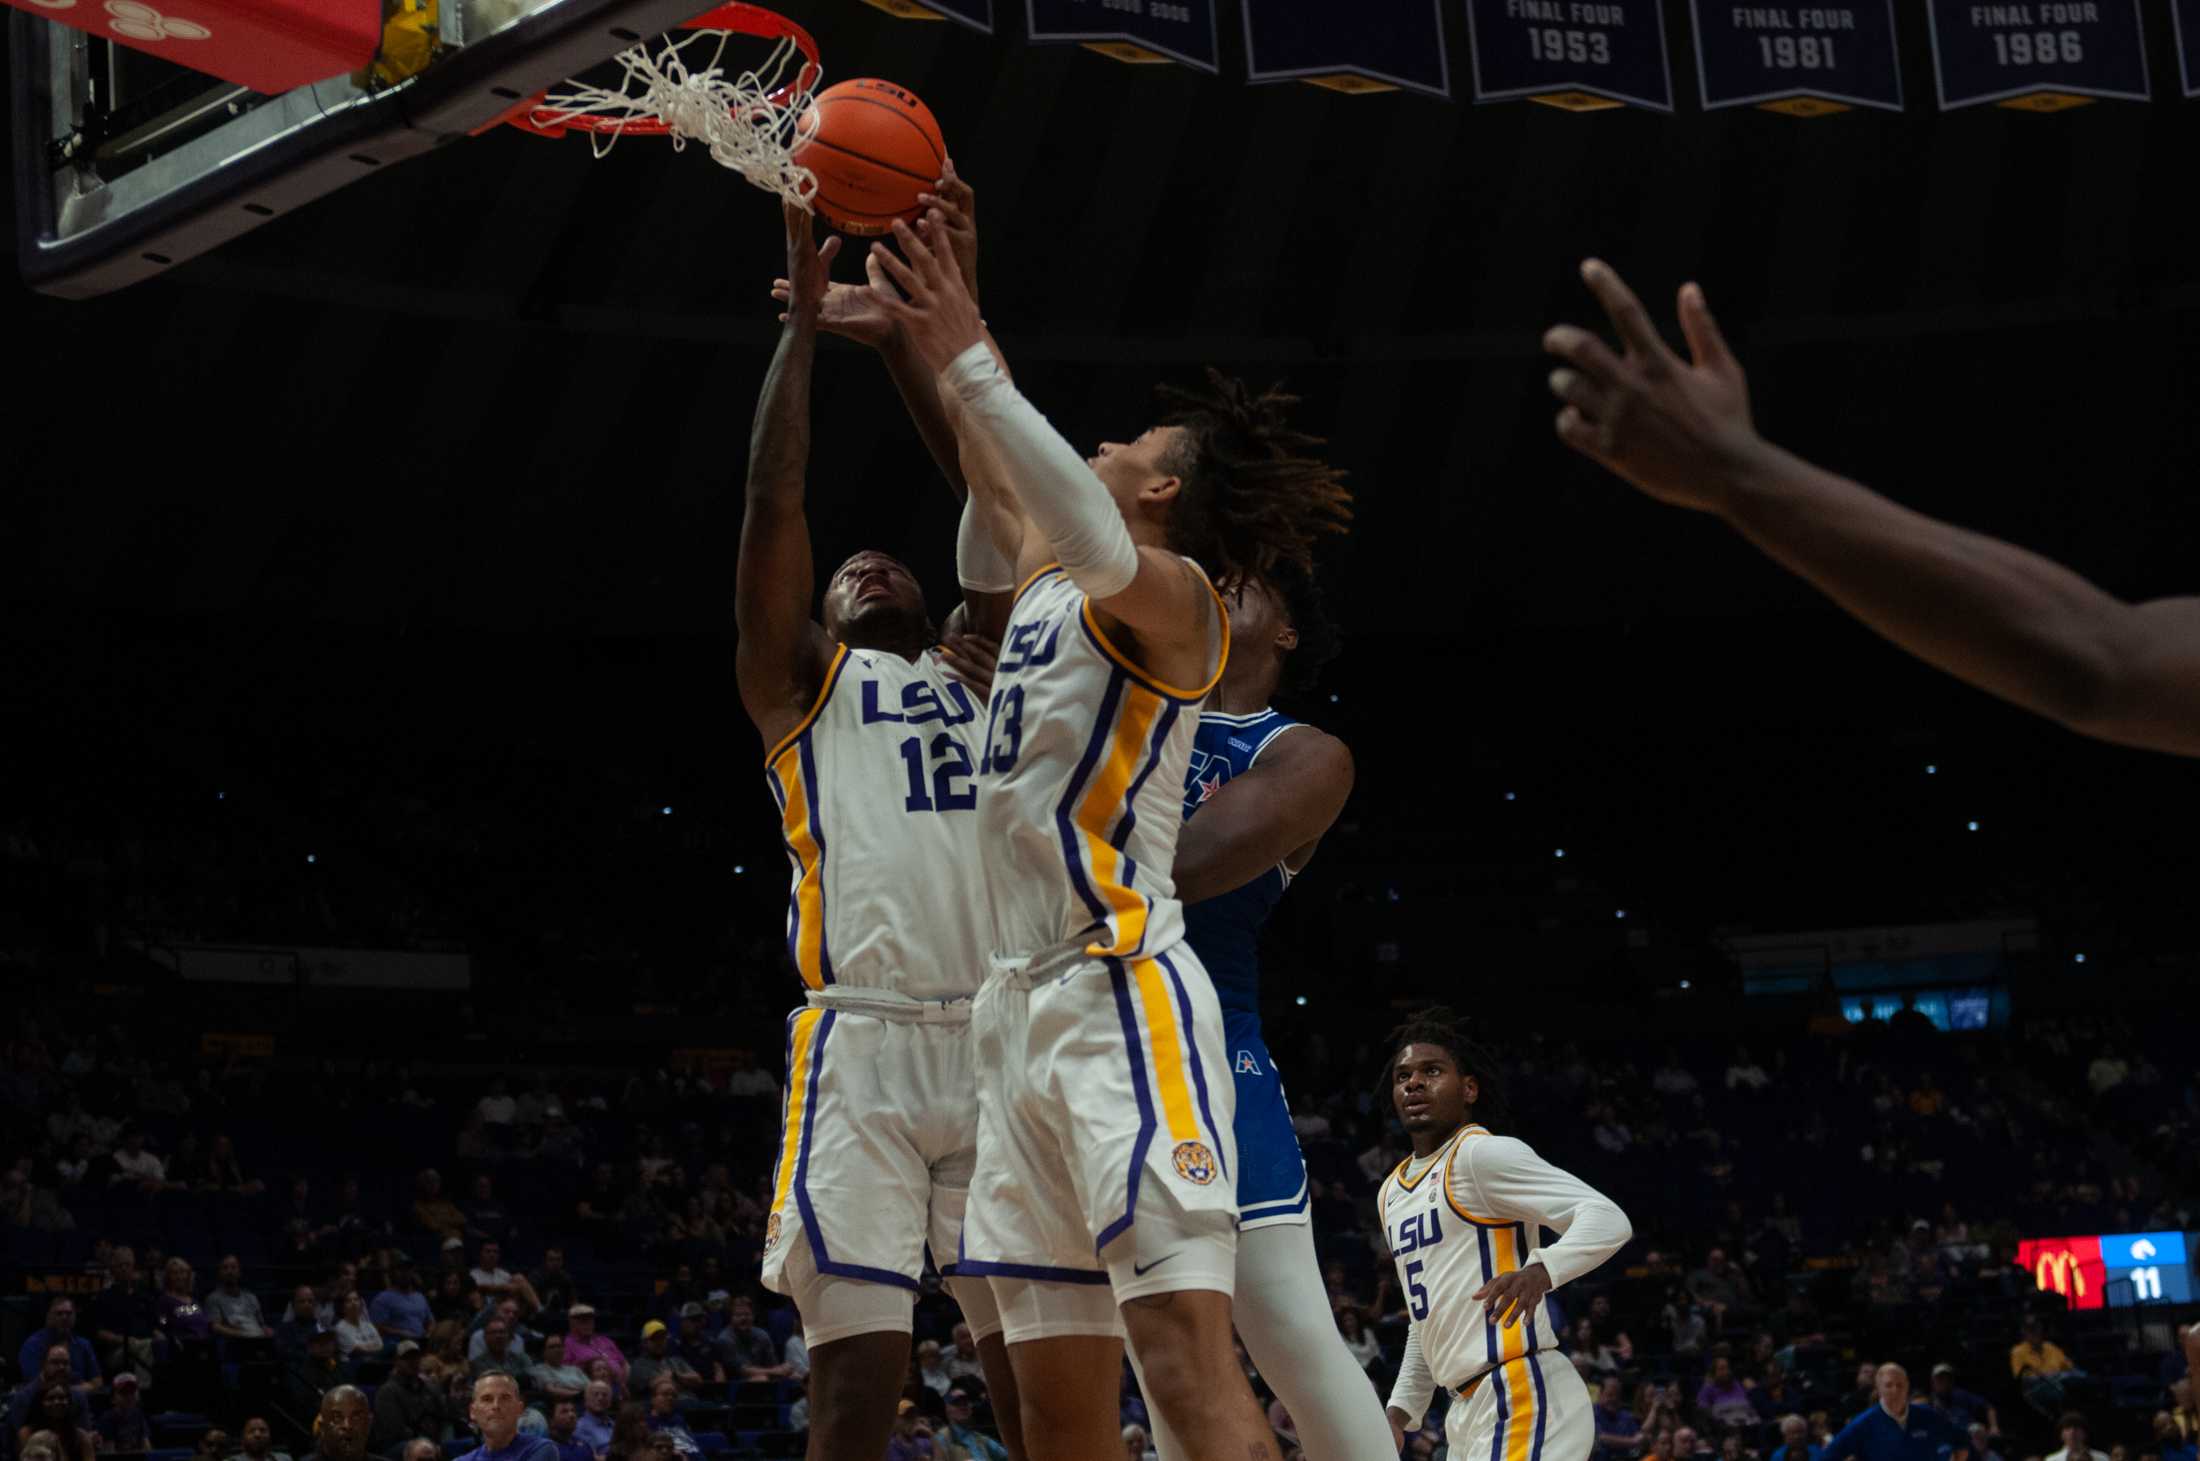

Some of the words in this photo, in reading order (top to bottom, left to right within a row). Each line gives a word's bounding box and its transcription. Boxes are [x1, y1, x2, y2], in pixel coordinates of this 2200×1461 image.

[1506, 0, 1565, 22] FINAL
[1570, 3, 1624, 27] FOUR
[1732, 7, 1793, 30] FINAL
[1799, 8, 1855, 31] FOUR
[1970, 5, 2034, 28] FINAL
[2039, 2, 2099, 24] FOUR
[1527, 27, 1611, 65] 1953
[1757, 35, 1836, 70] 1981
[1992, 30, 2083, 66] 1986
[861, 680, 975, 727] LSU
[900, 732, 977, 812] 12
[1388, 1208, 1443, 1258] LSU
[1406, 1259, 1429, 1321] 5
[2130, 1266, 2162, 1300] 11
